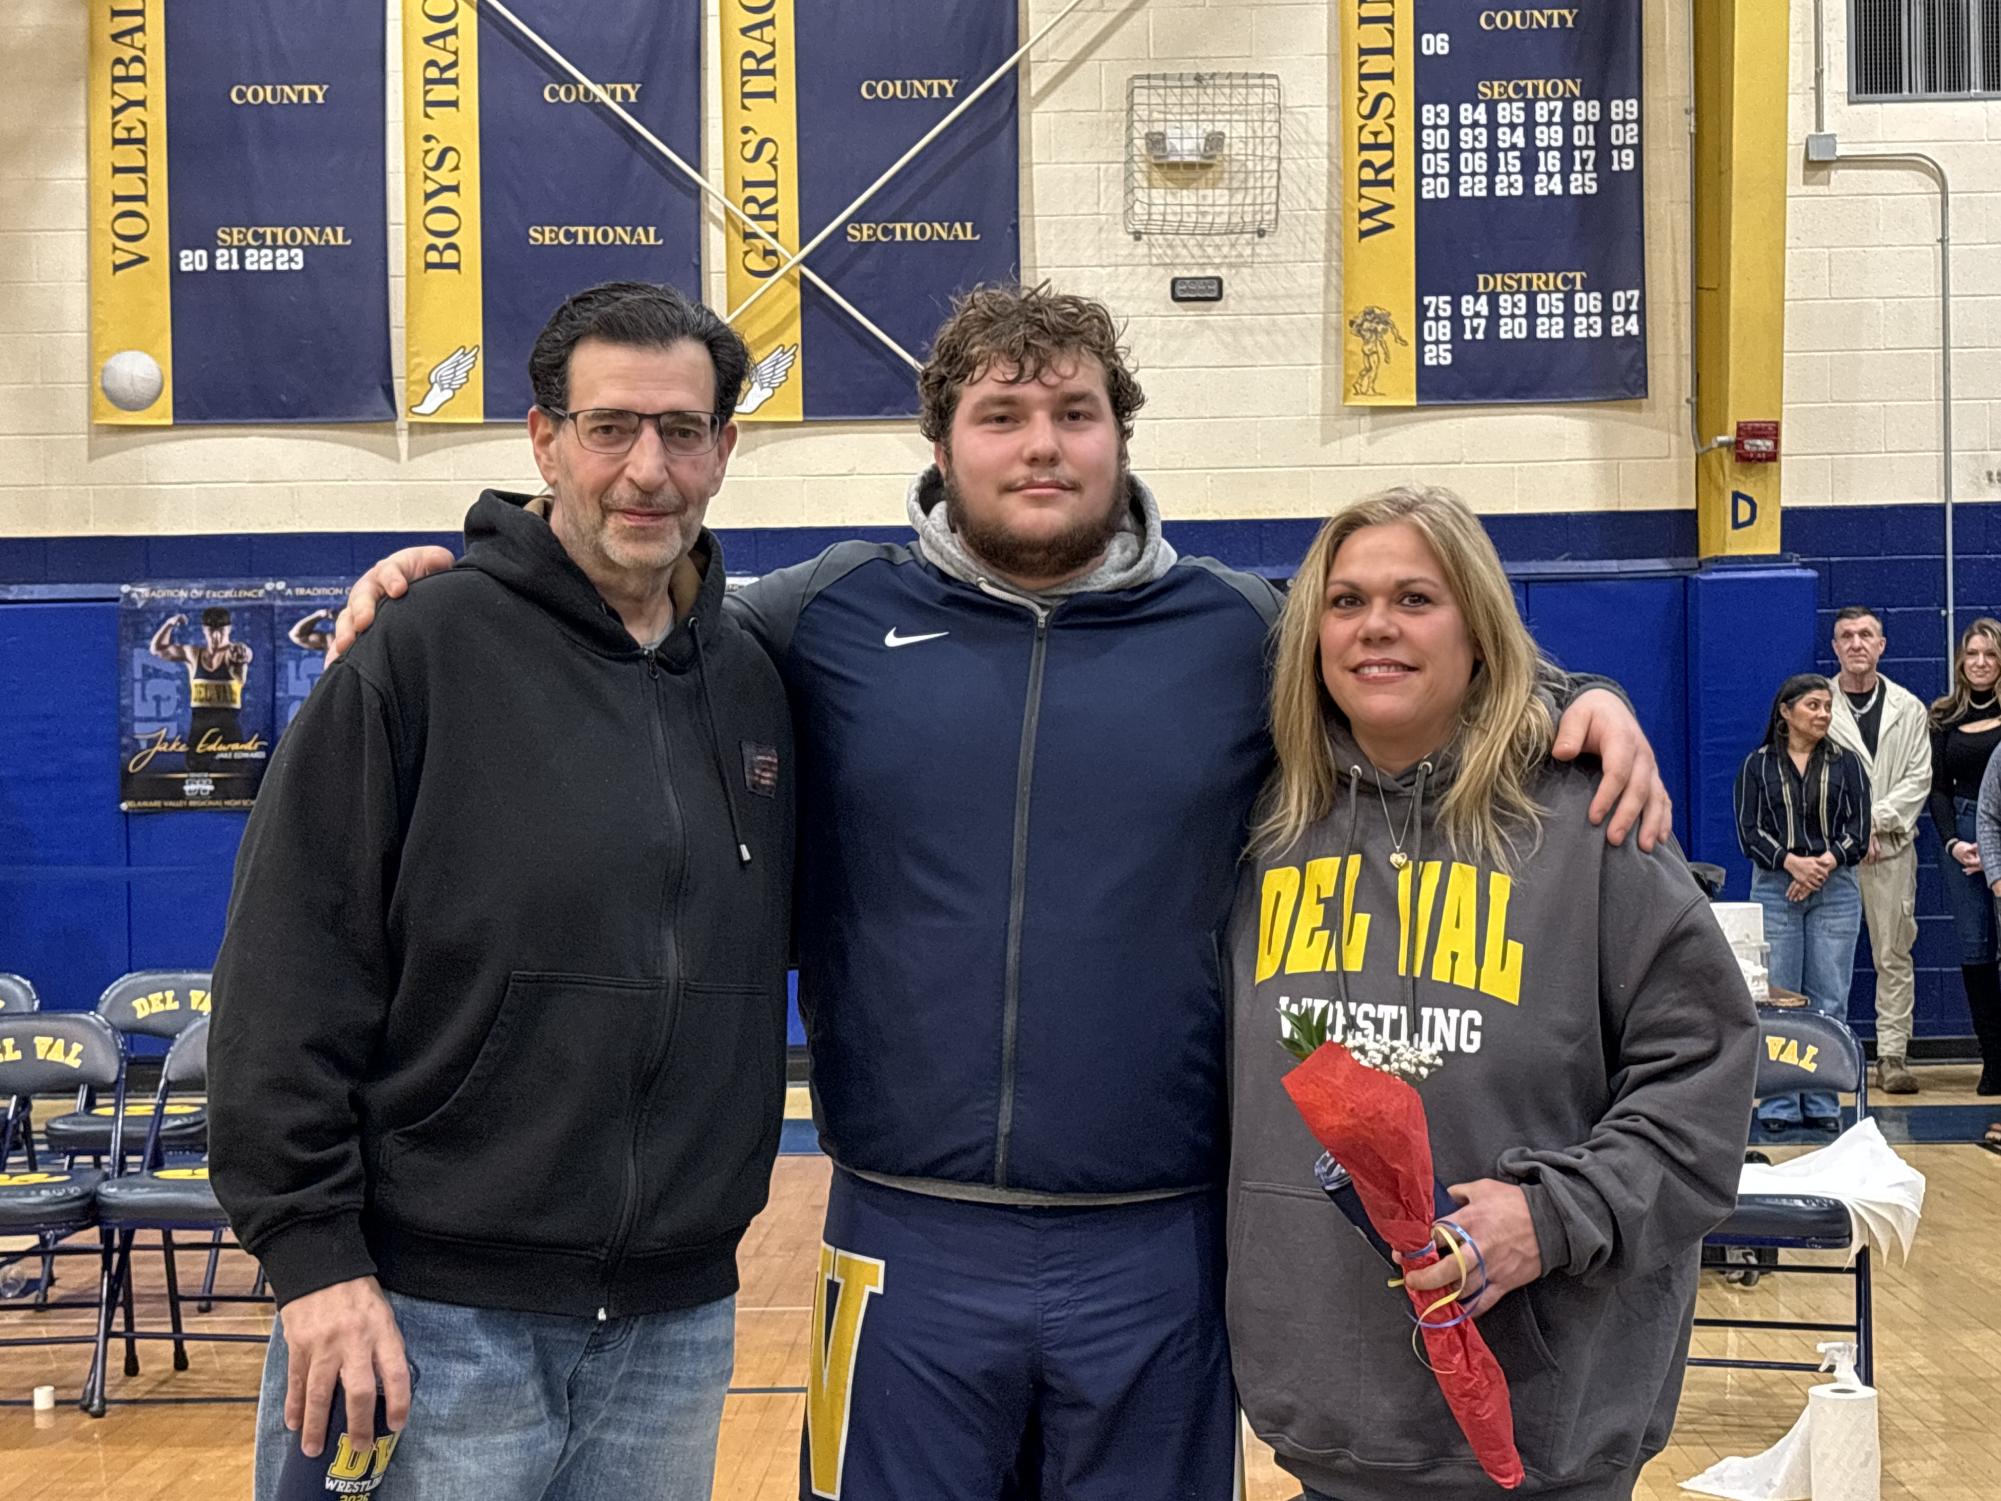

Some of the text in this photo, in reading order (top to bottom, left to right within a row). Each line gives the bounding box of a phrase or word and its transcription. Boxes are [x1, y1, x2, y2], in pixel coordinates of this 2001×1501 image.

[1479, 9, 1578, 30] COUNTY
[1421, 33, 1449, 55] 06
[230, 84, 329, 105] COUNTY
[543, 83, 641, 103] COUNTY
[860, 79, 958, 99] COUNTY
[1477, 79, 1581, 100] SECTION
[1421, 99, 1638, 126] 83 84 85 87 88 89
[1422, 124, 1638, 150] 90 93 94 99 01 02
[1422, 149, 1634, 175] 05 06 15 16 17 19
[1422, 173, 1597, 198] 20 22 23 24 25
[217, 226, 352, 247] SECTIONAL
[528, 225, 663, 246] SECTIONAL
[846, 222, 980, 242] SECTIONAL
[179, 249, 304, 271] 20 21 22 23
[1476, 272, 1586, 293] DISTRICT
[1423, 290, 1640, 317] 75 84 93 05 06 07
[1424, 315, 1639, 341] 08 17 20 22 23 24
[1424, 344, 1452, 365] 25
[1731, 490, 1758, 530] D
[295, 587, 343, 596] TRADITION
[1255, 854, 1524, 1006] DEL VAL
[132, 990, 179, 1019] DEL
[33, 1036, 84, 1068] VAL
[1765, 1035, 1819, 1073] VAL
